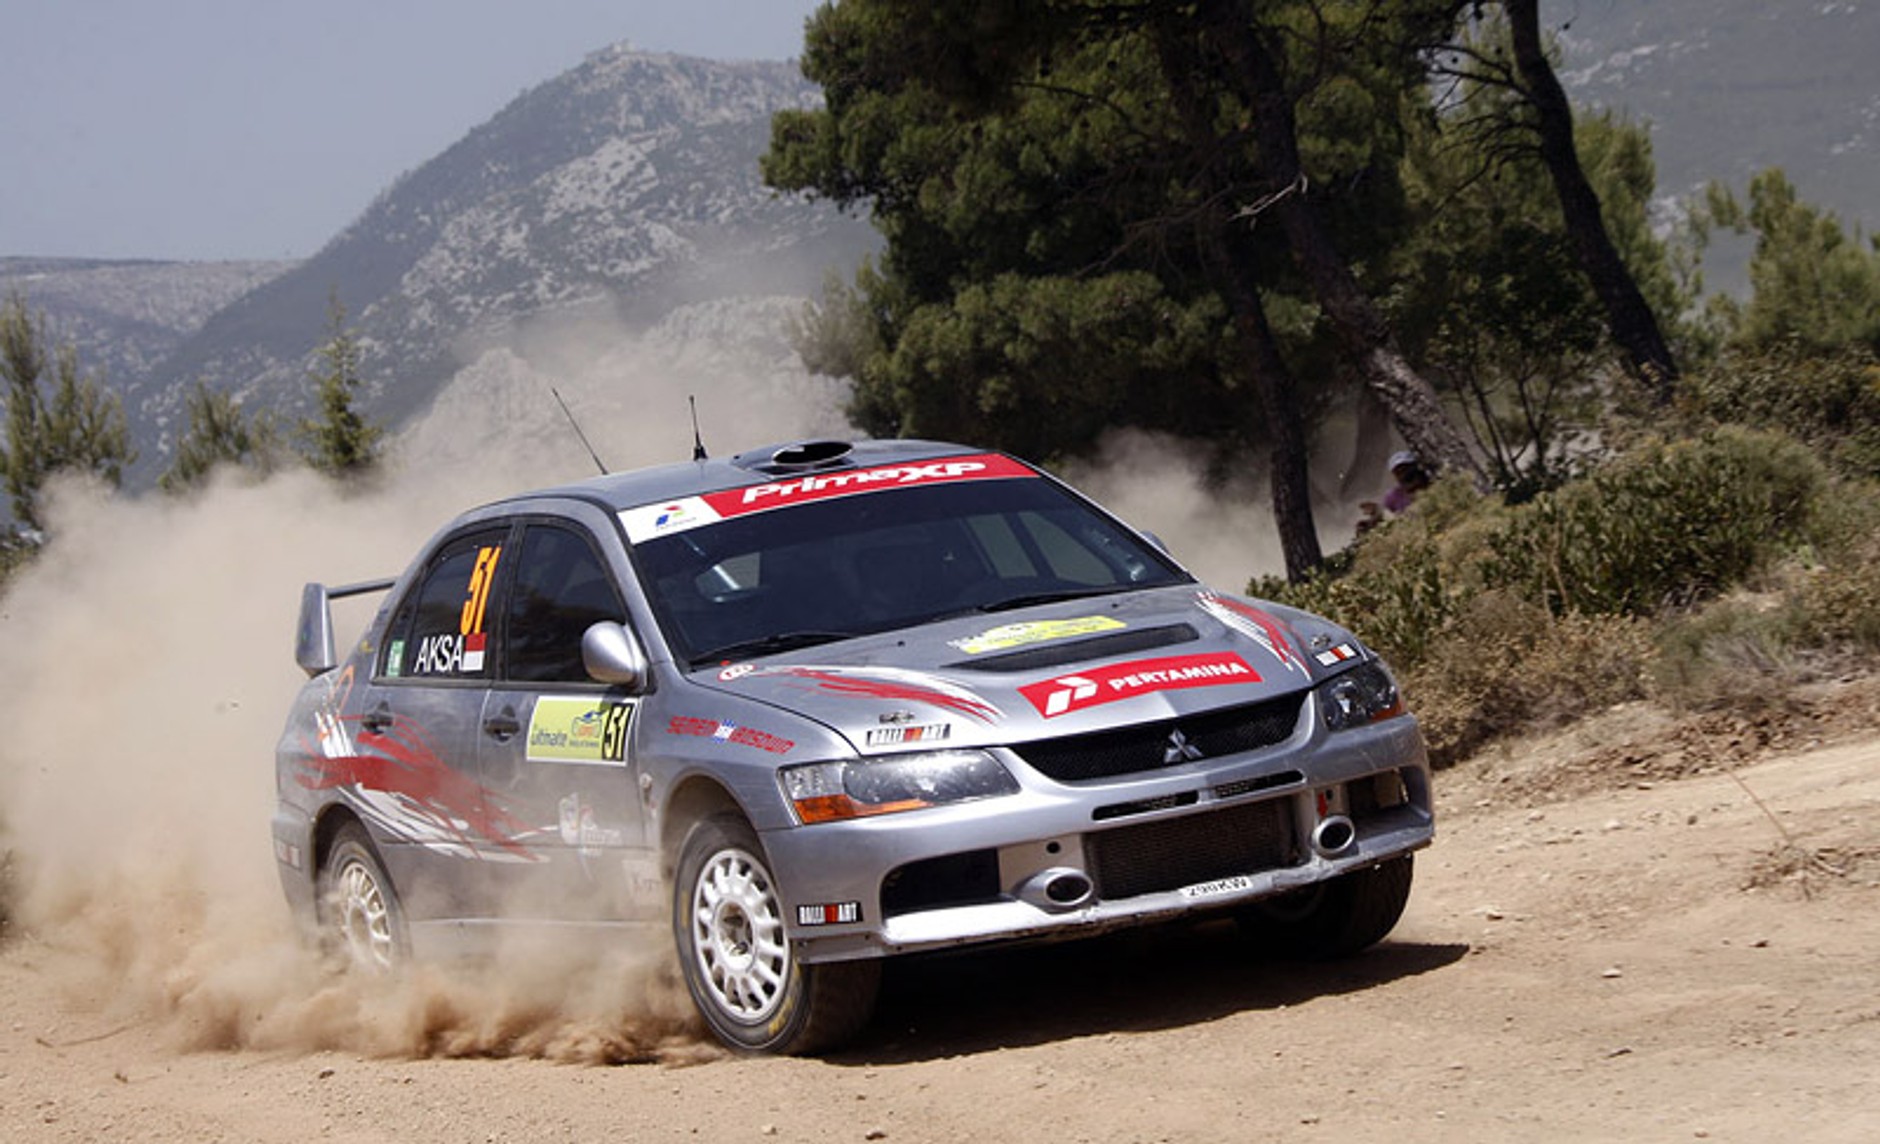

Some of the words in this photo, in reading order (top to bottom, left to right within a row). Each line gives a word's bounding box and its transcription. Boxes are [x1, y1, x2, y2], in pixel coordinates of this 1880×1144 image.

[460, 545, 502, 636] 51
[413, 634, 464, 673] AKSA
[1107, 662, 1249, 691] PERTAMINA
[604, 706, 631, 759] 51
